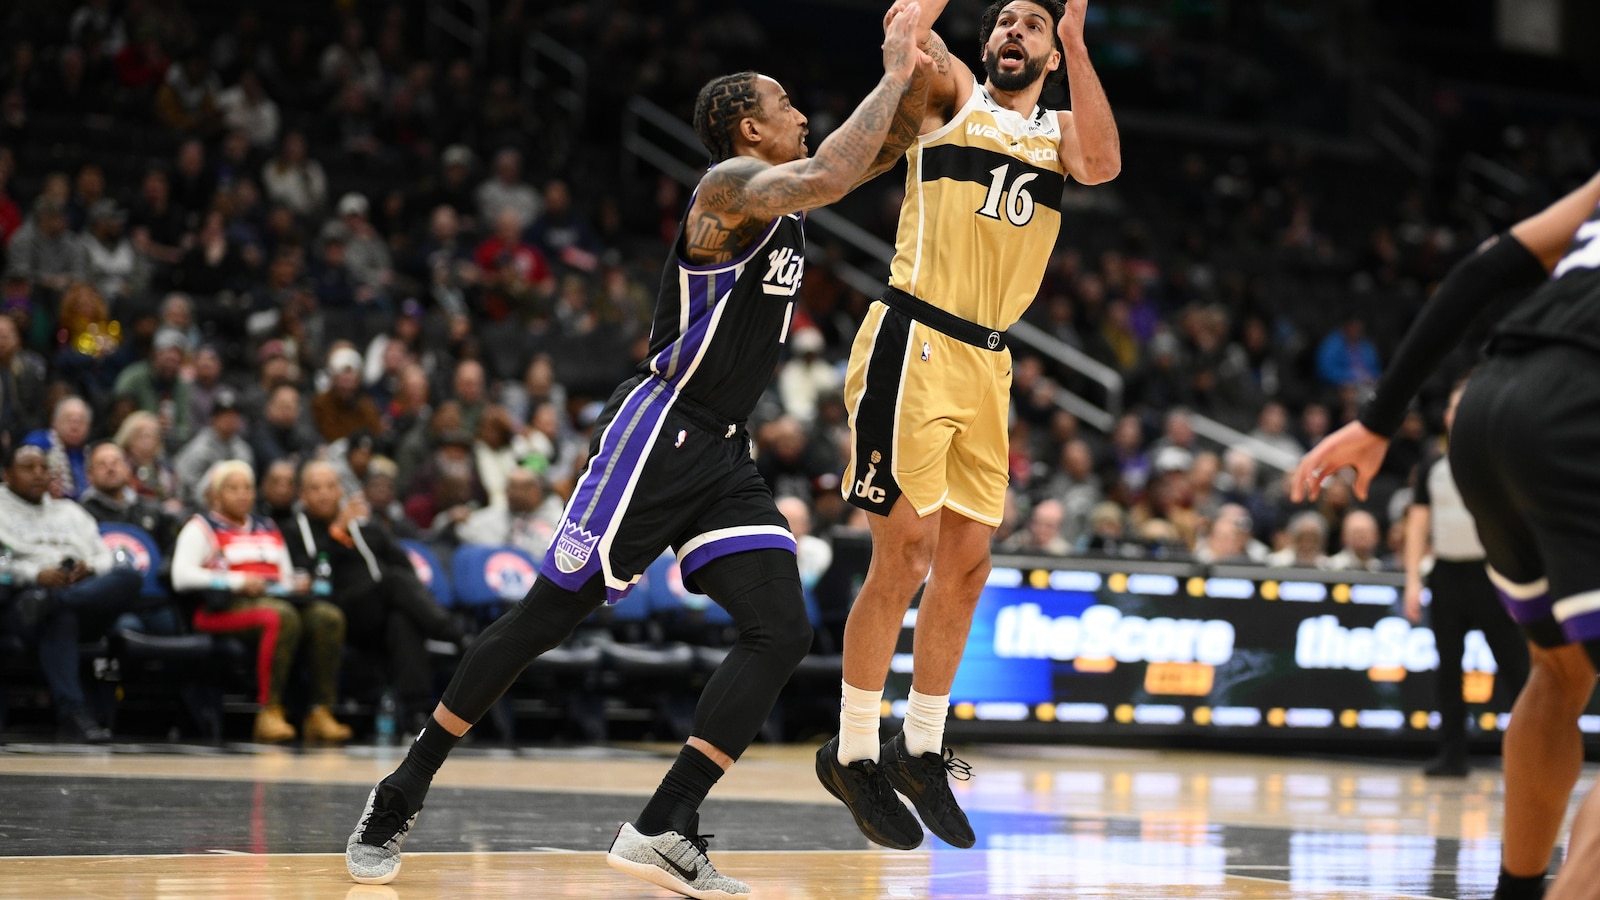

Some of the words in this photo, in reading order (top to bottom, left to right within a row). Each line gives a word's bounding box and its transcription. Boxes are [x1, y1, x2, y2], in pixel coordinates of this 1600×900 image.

[975, 163, 1039, 226] 16
[559, 539, 590, 562] KINGS
[993, 602, 1236, 666] theScore
